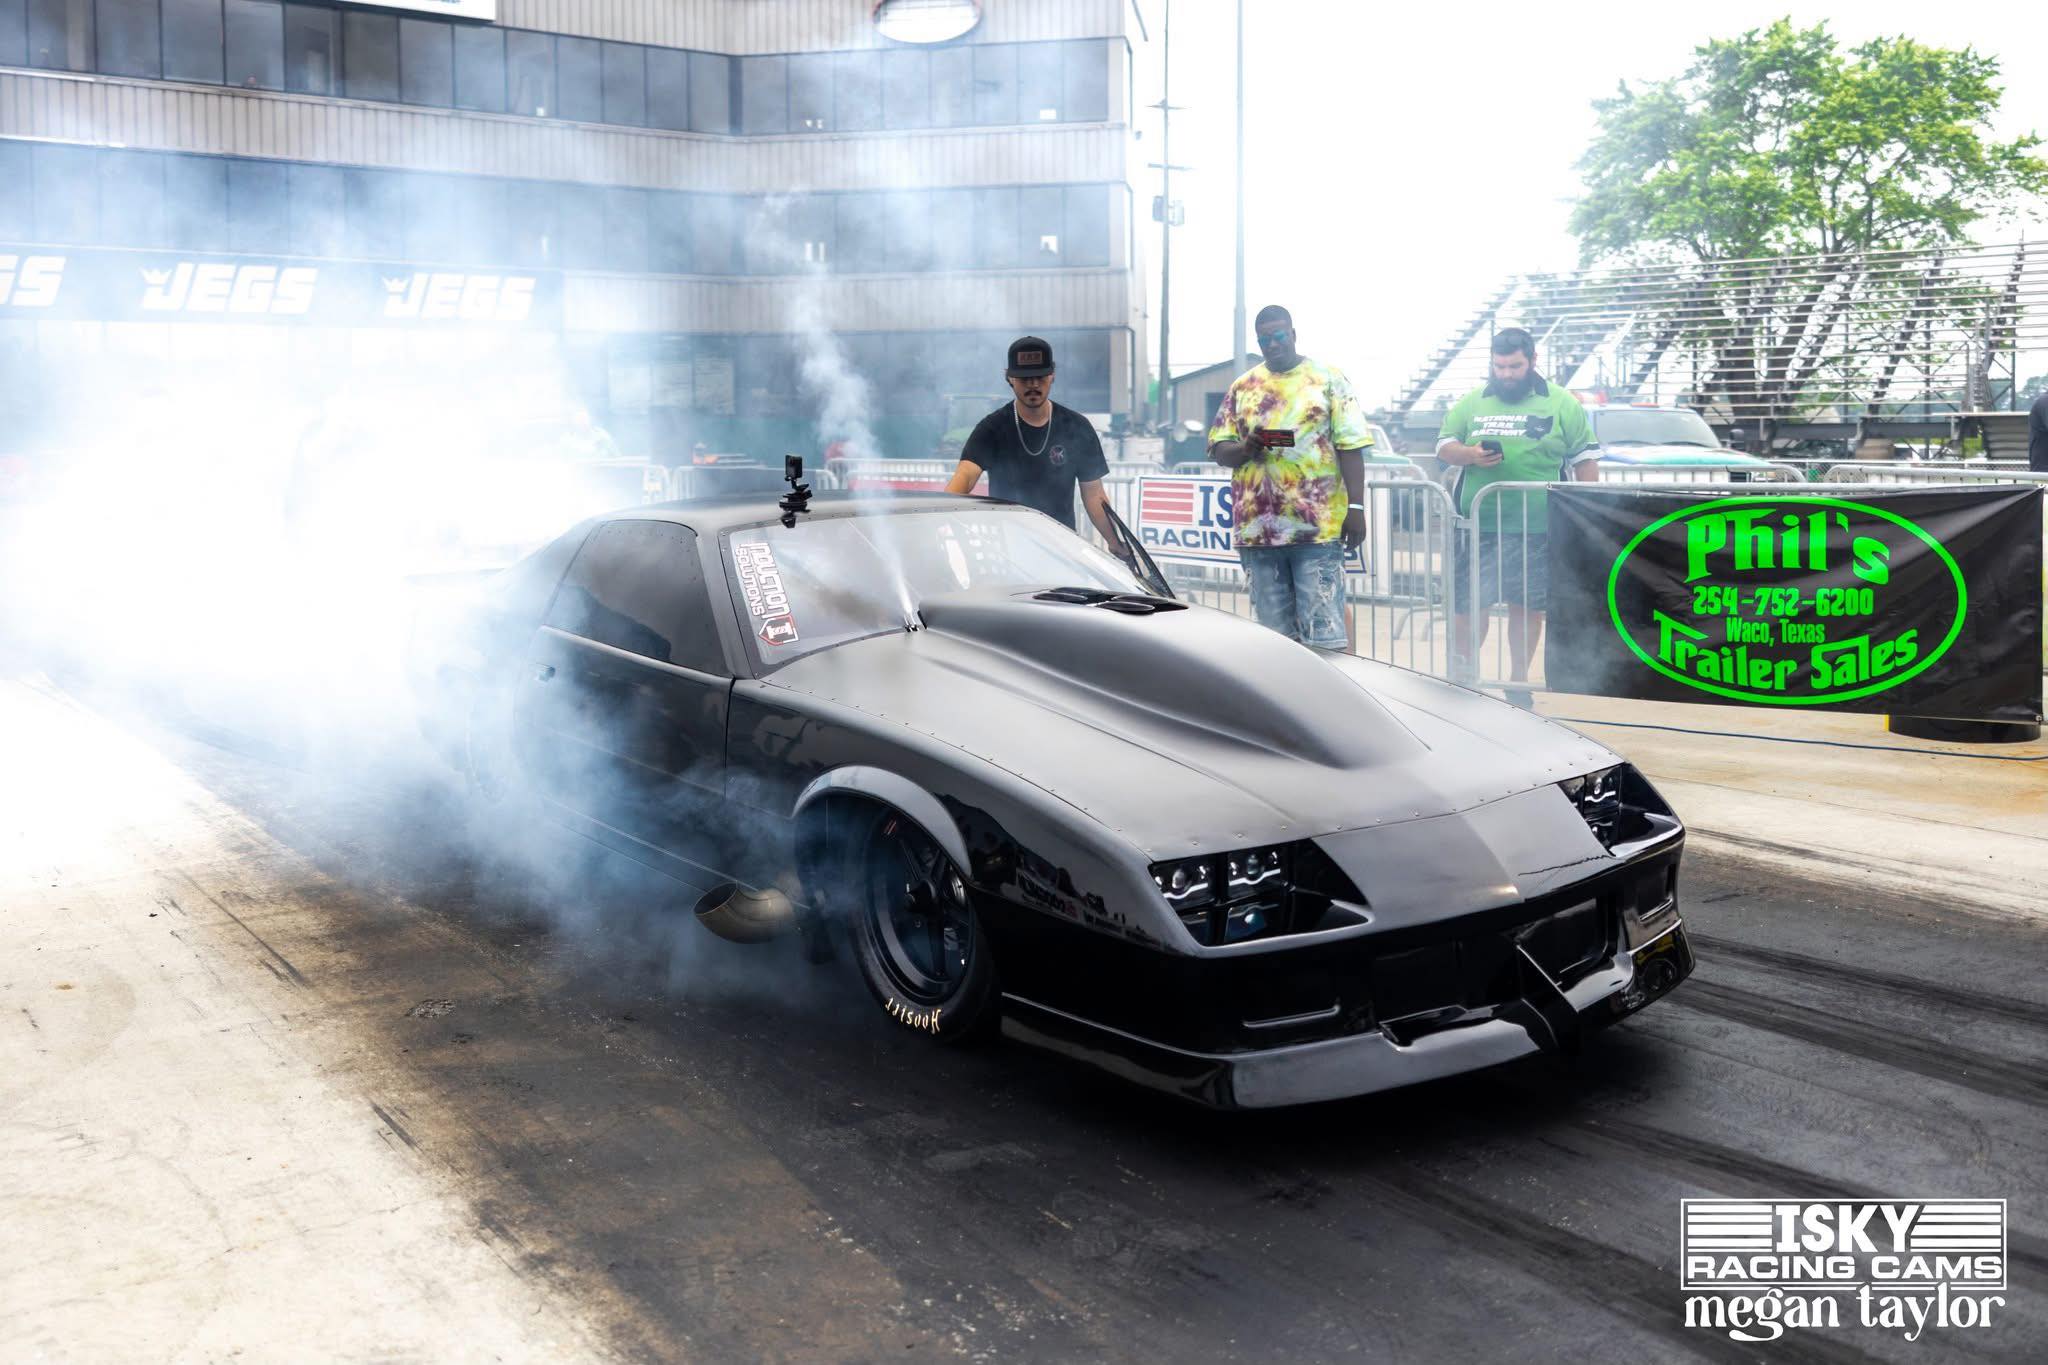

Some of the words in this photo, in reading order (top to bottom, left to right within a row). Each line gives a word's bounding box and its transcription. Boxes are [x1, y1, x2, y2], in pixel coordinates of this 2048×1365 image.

[142, 262, 318, 314] JEGS
[384, 272, 536, 320] JEGS
[1198, 485, 1233, 528] IS
[1142, 526, 1231, 551] RACIN
[1684, 508, 1890, 584] Phil's
[1693, 585, 1874, 616] 254-752-6200
[1653, 609, 1797, 690] Trailer
[1810, 629, 1918, 690] Sales
[1726, 617, 1775, 647] Waco,
[1780, 618, 1825, 643] Texas
